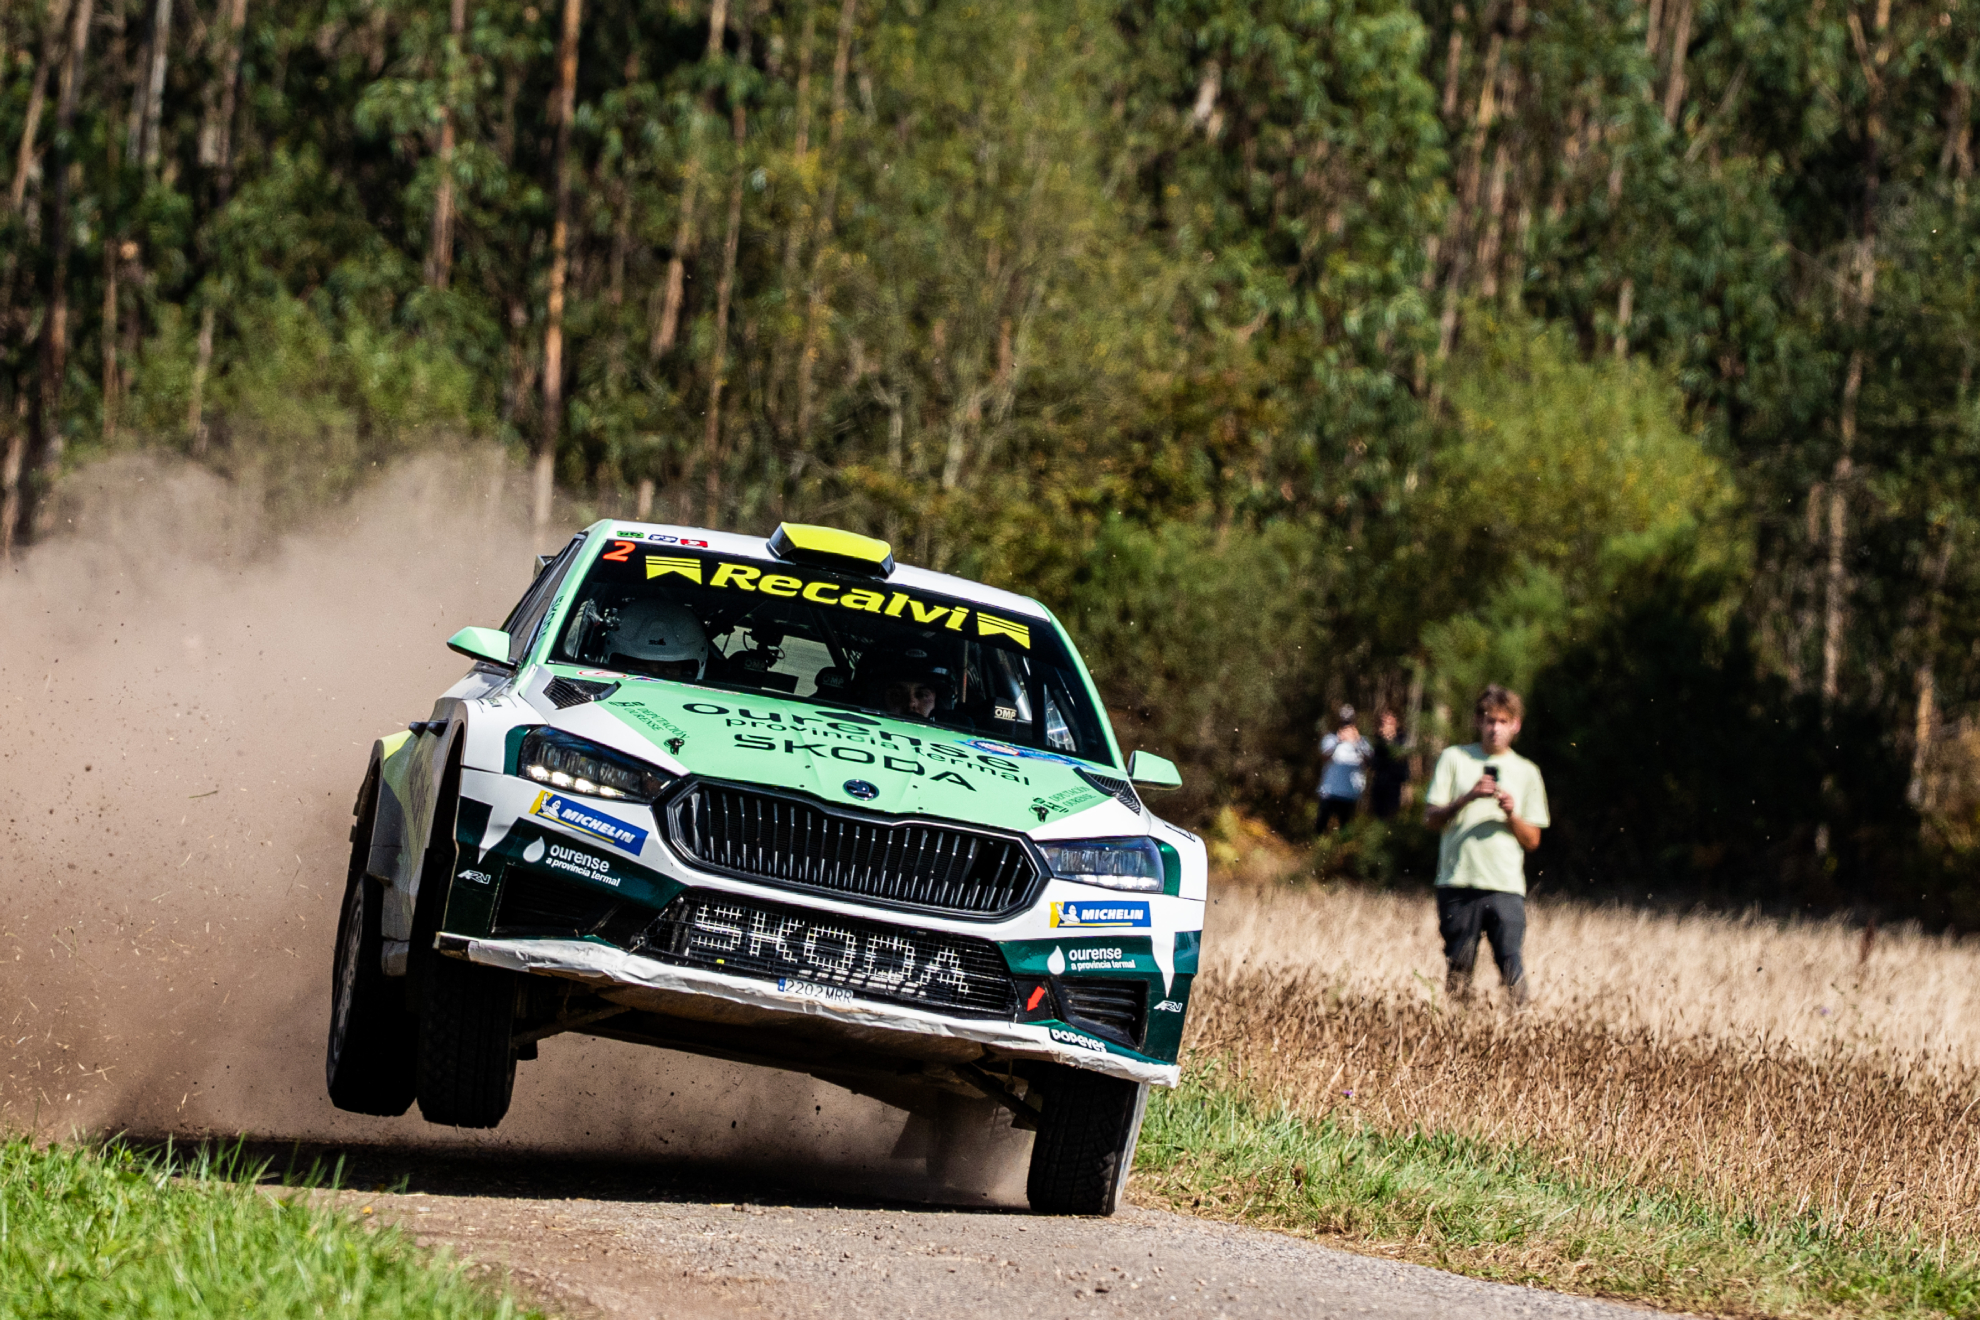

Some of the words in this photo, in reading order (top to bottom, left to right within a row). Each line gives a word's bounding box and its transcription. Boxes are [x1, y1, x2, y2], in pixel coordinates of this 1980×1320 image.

[602, 540, 637, 562] 2
[709, 562, 970, 632] Recalvi
[994, 708, 1017, 720] OMP
[682, 703, 1021, 773] ourense
[725, 718, 900, 751] provincia
[913, 745, 1031, 786] termal
[733, 734, 978, 792] SKODA
[560, 808, 636, 845] MICHELIN
[545, 857, 554, 865] a
[550, 858, 592, 878] provincia
[590, 870, 621, 887] termal
[549, 844, 610, 873] ourense
[1081, 908, 1144, 920] MICHELIN
[690, 904, 970, 996] SKODA
[1068, 947, 1123, 961] ourense
[1070, 962, 1078, 970] a
[1077, 959, 1111, 972] provincia
[1111, 959, 1137, 969] termal
[785, 979, 824, 998] 2202
[824, 986, 853, 1004] MRR
